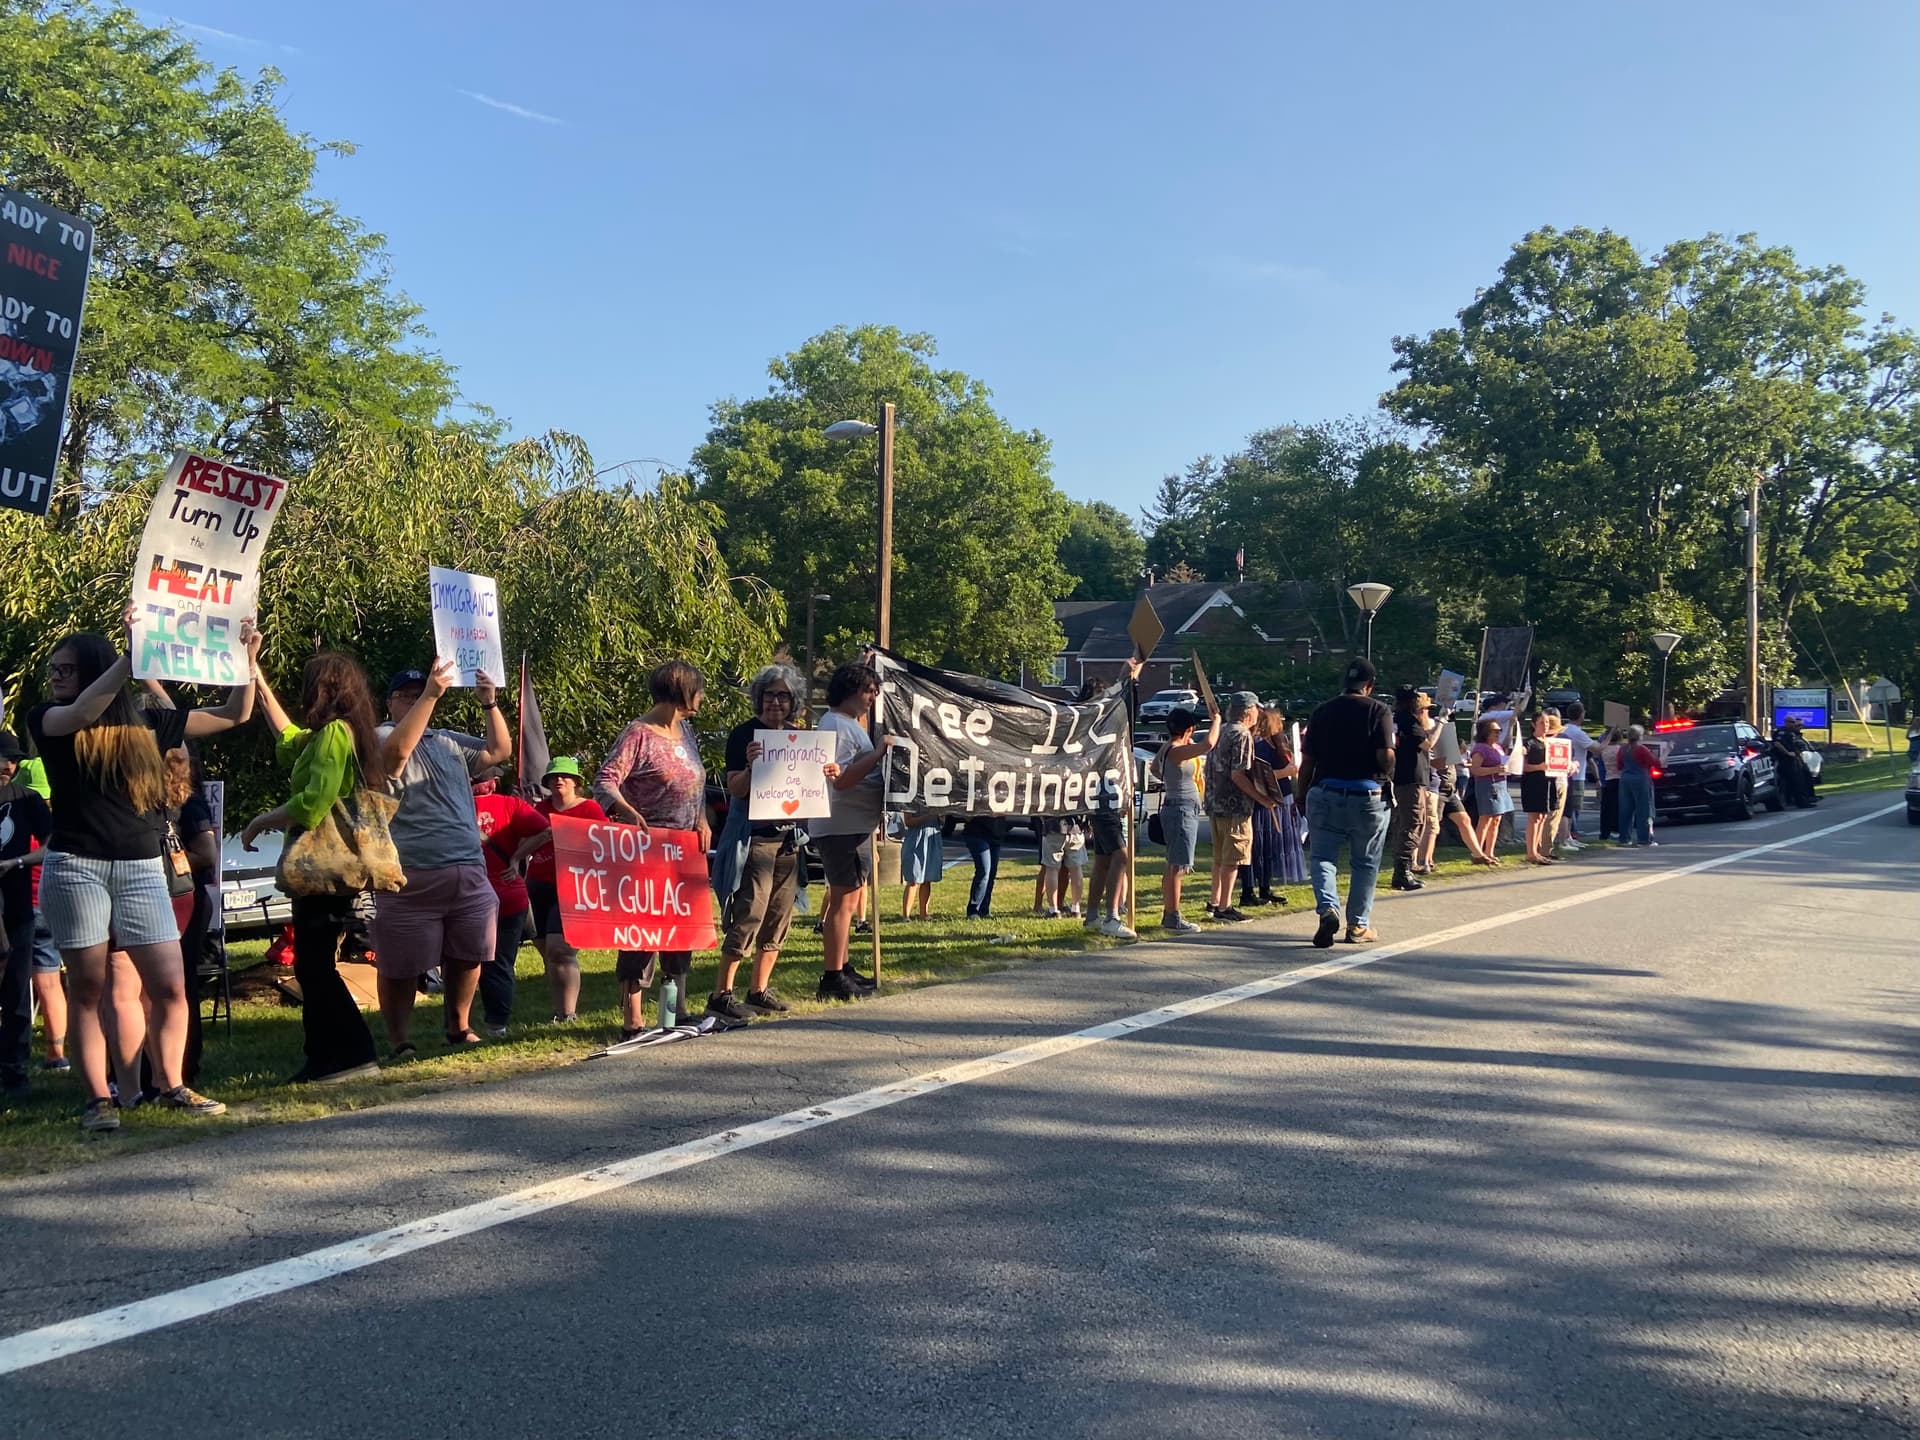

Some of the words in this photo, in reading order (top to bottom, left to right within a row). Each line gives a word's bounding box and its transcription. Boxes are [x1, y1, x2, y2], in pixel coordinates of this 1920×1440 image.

[59, 222, 85, 251] TO
[7, 242, 63, 281] NICE
[45, 310, 72, 339] TO
[177, 454, 284, 511] RESIST
[169, 489, 222, 532] Turn
[232, 507, 260, 553] Up
[190, 535, 205, 549] the
[148, 554, 243, 605] HEAT
[178, 599, 202, 613] and
[432, 582, 494, 617] IMMIGRANTS
[146, 603, 230, 652] ICE
[450, 625, 464, 640] MAKE
[466, 626, 488, 641] AMERICA
[141, 639, 235, 682] MELTS
[455, 648, 487, 670] GREAT!
[875, 652, 993, 747] Free
[762, 738, 827, 772] Immigrants
[1553, 745, 1565, 757] NO
[756, 786, 795, 799] welcome
[801, 781, 825, 799] here!
[786, 776, 800, 785] are
[588, 824, 651, 864] STOP
[661, 843, 684, 862] THE
[568, 866, 611, 912] ICE
[618, 875, 692, 917] GULAG
[613, 924, 677, 948] NOW!
